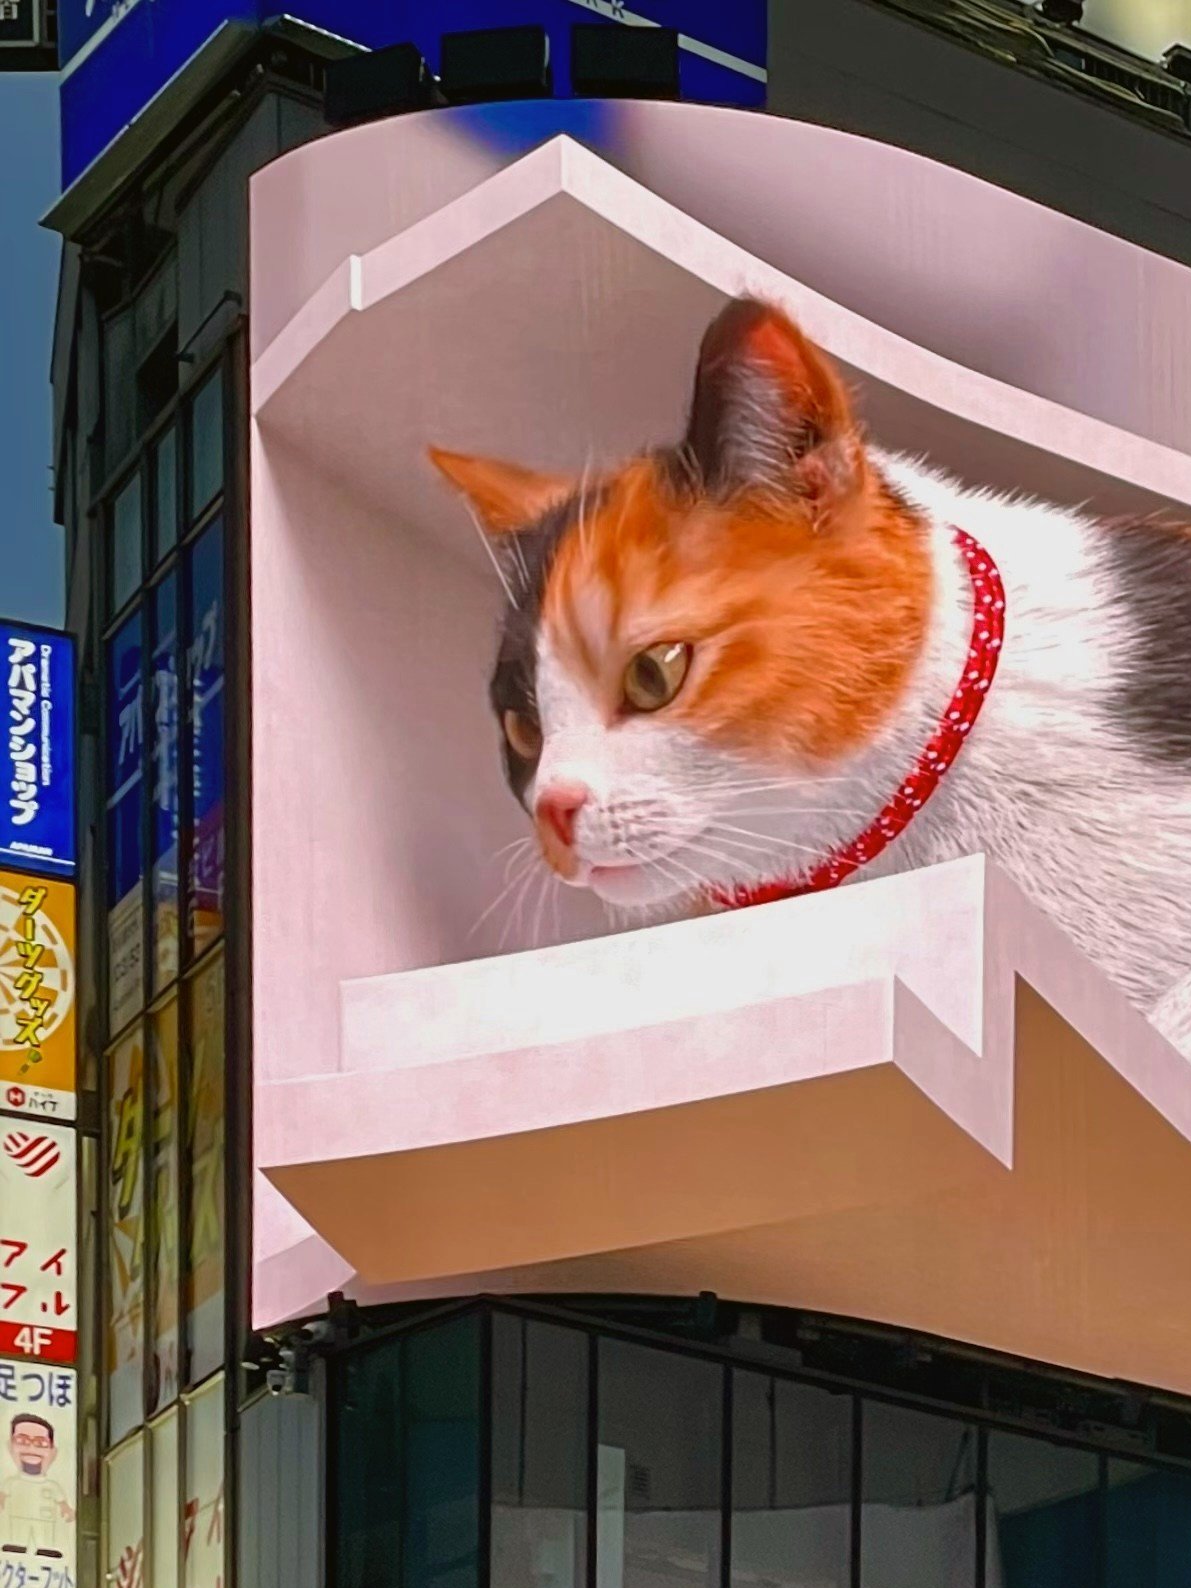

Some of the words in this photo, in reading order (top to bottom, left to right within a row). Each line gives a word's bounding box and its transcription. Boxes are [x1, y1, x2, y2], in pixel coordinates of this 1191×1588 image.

[8, 637, 39, 826] アパマンショップ
[14, 1326, 53, 1355] 4F
